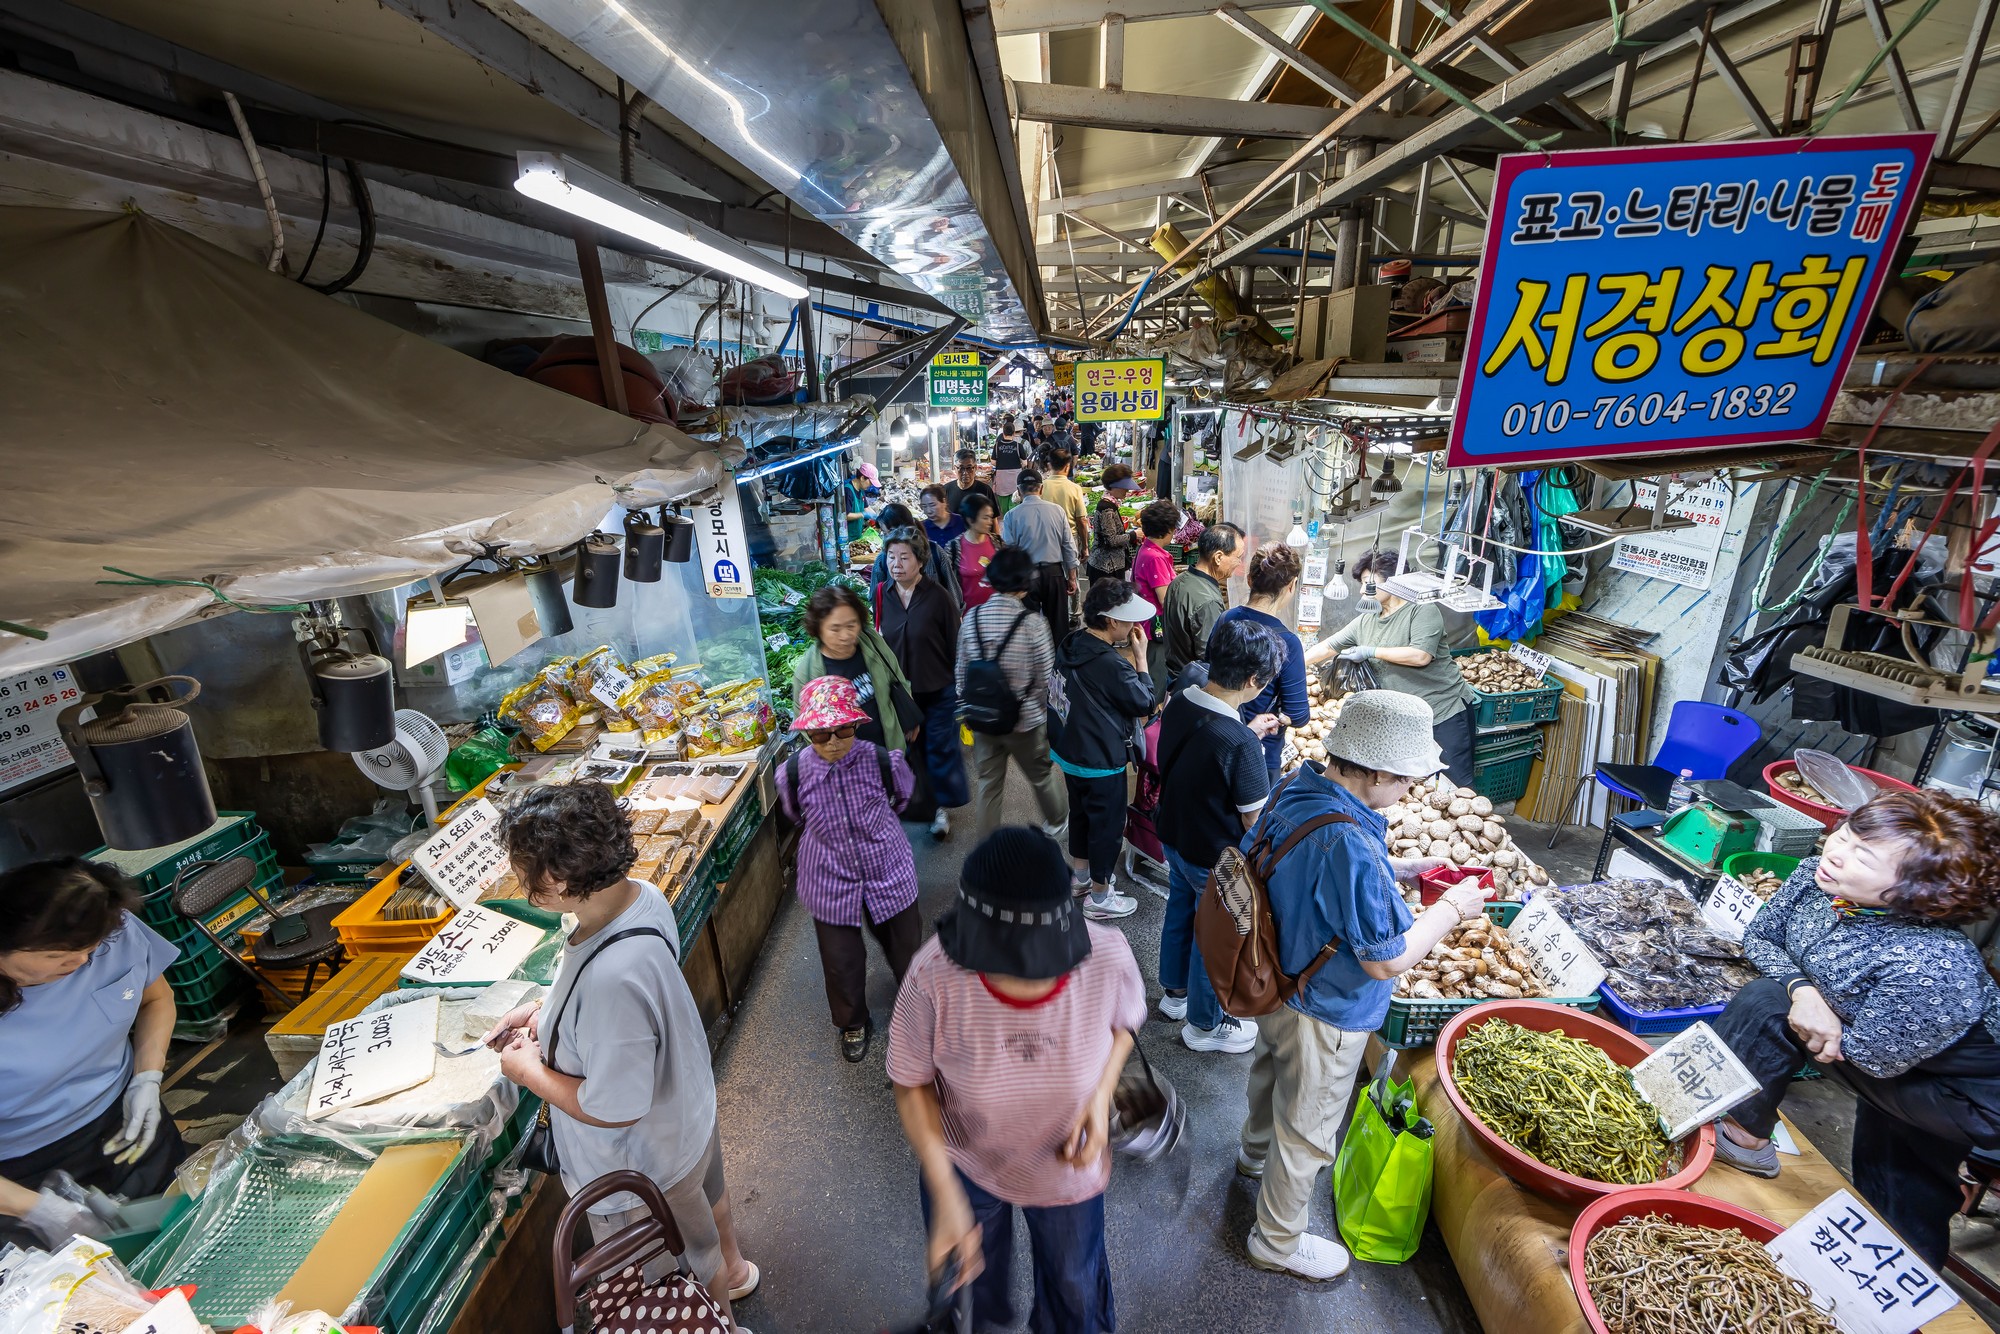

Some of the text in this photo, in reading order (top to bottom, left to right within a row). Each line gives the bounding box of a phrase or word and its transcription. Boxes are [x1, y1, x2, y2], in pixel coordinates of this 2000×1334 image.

[1849, 161, 1905, 244] 도매
[1482, 254, 1870, 386] 서경상회
[943, 354, 969, 364] 김서방
[933, 379, 984, 395] 대명농산
[1080, 389, 1159, 414] 용화상회
[1501, 382, 1798, 437] 010-7604-1832
[1637, 487, 1646, 497] 13
[1647, 489, 1657, 498] 14
[1688, 495, 1699, 504] 17
[1701, 497, 1711, 506] 18
[1714, 499, 1724, 509] 19
[1684, 511, 1694, 520] 24
[1696, 513, 1707, 523] 25
[1708, 515, 1720, 526] 26
[1620, 543, 1658, 558] 경동시장
[1660, 552, 1708, 571] 상인연합회
[15, 680, 28, 692] 17
[34, 675, 49, 687] 18
[52, 670, 67, 681] 19
[4, 688, 77, 718] 23 24 25 26
[14, 724, 31, 737] 30
[427, 838, 451, 860] 진짜
[449, 818, 475, 842] 도토리
[471, 809, 486, 822] 묵
[175, 850, 202, 871] 우이식품
[1713, 886, 1743, 921] 능이
[1721, 877, 1756, 910] 자연산
[1826, 1206, 1941, 1308] 고사리
